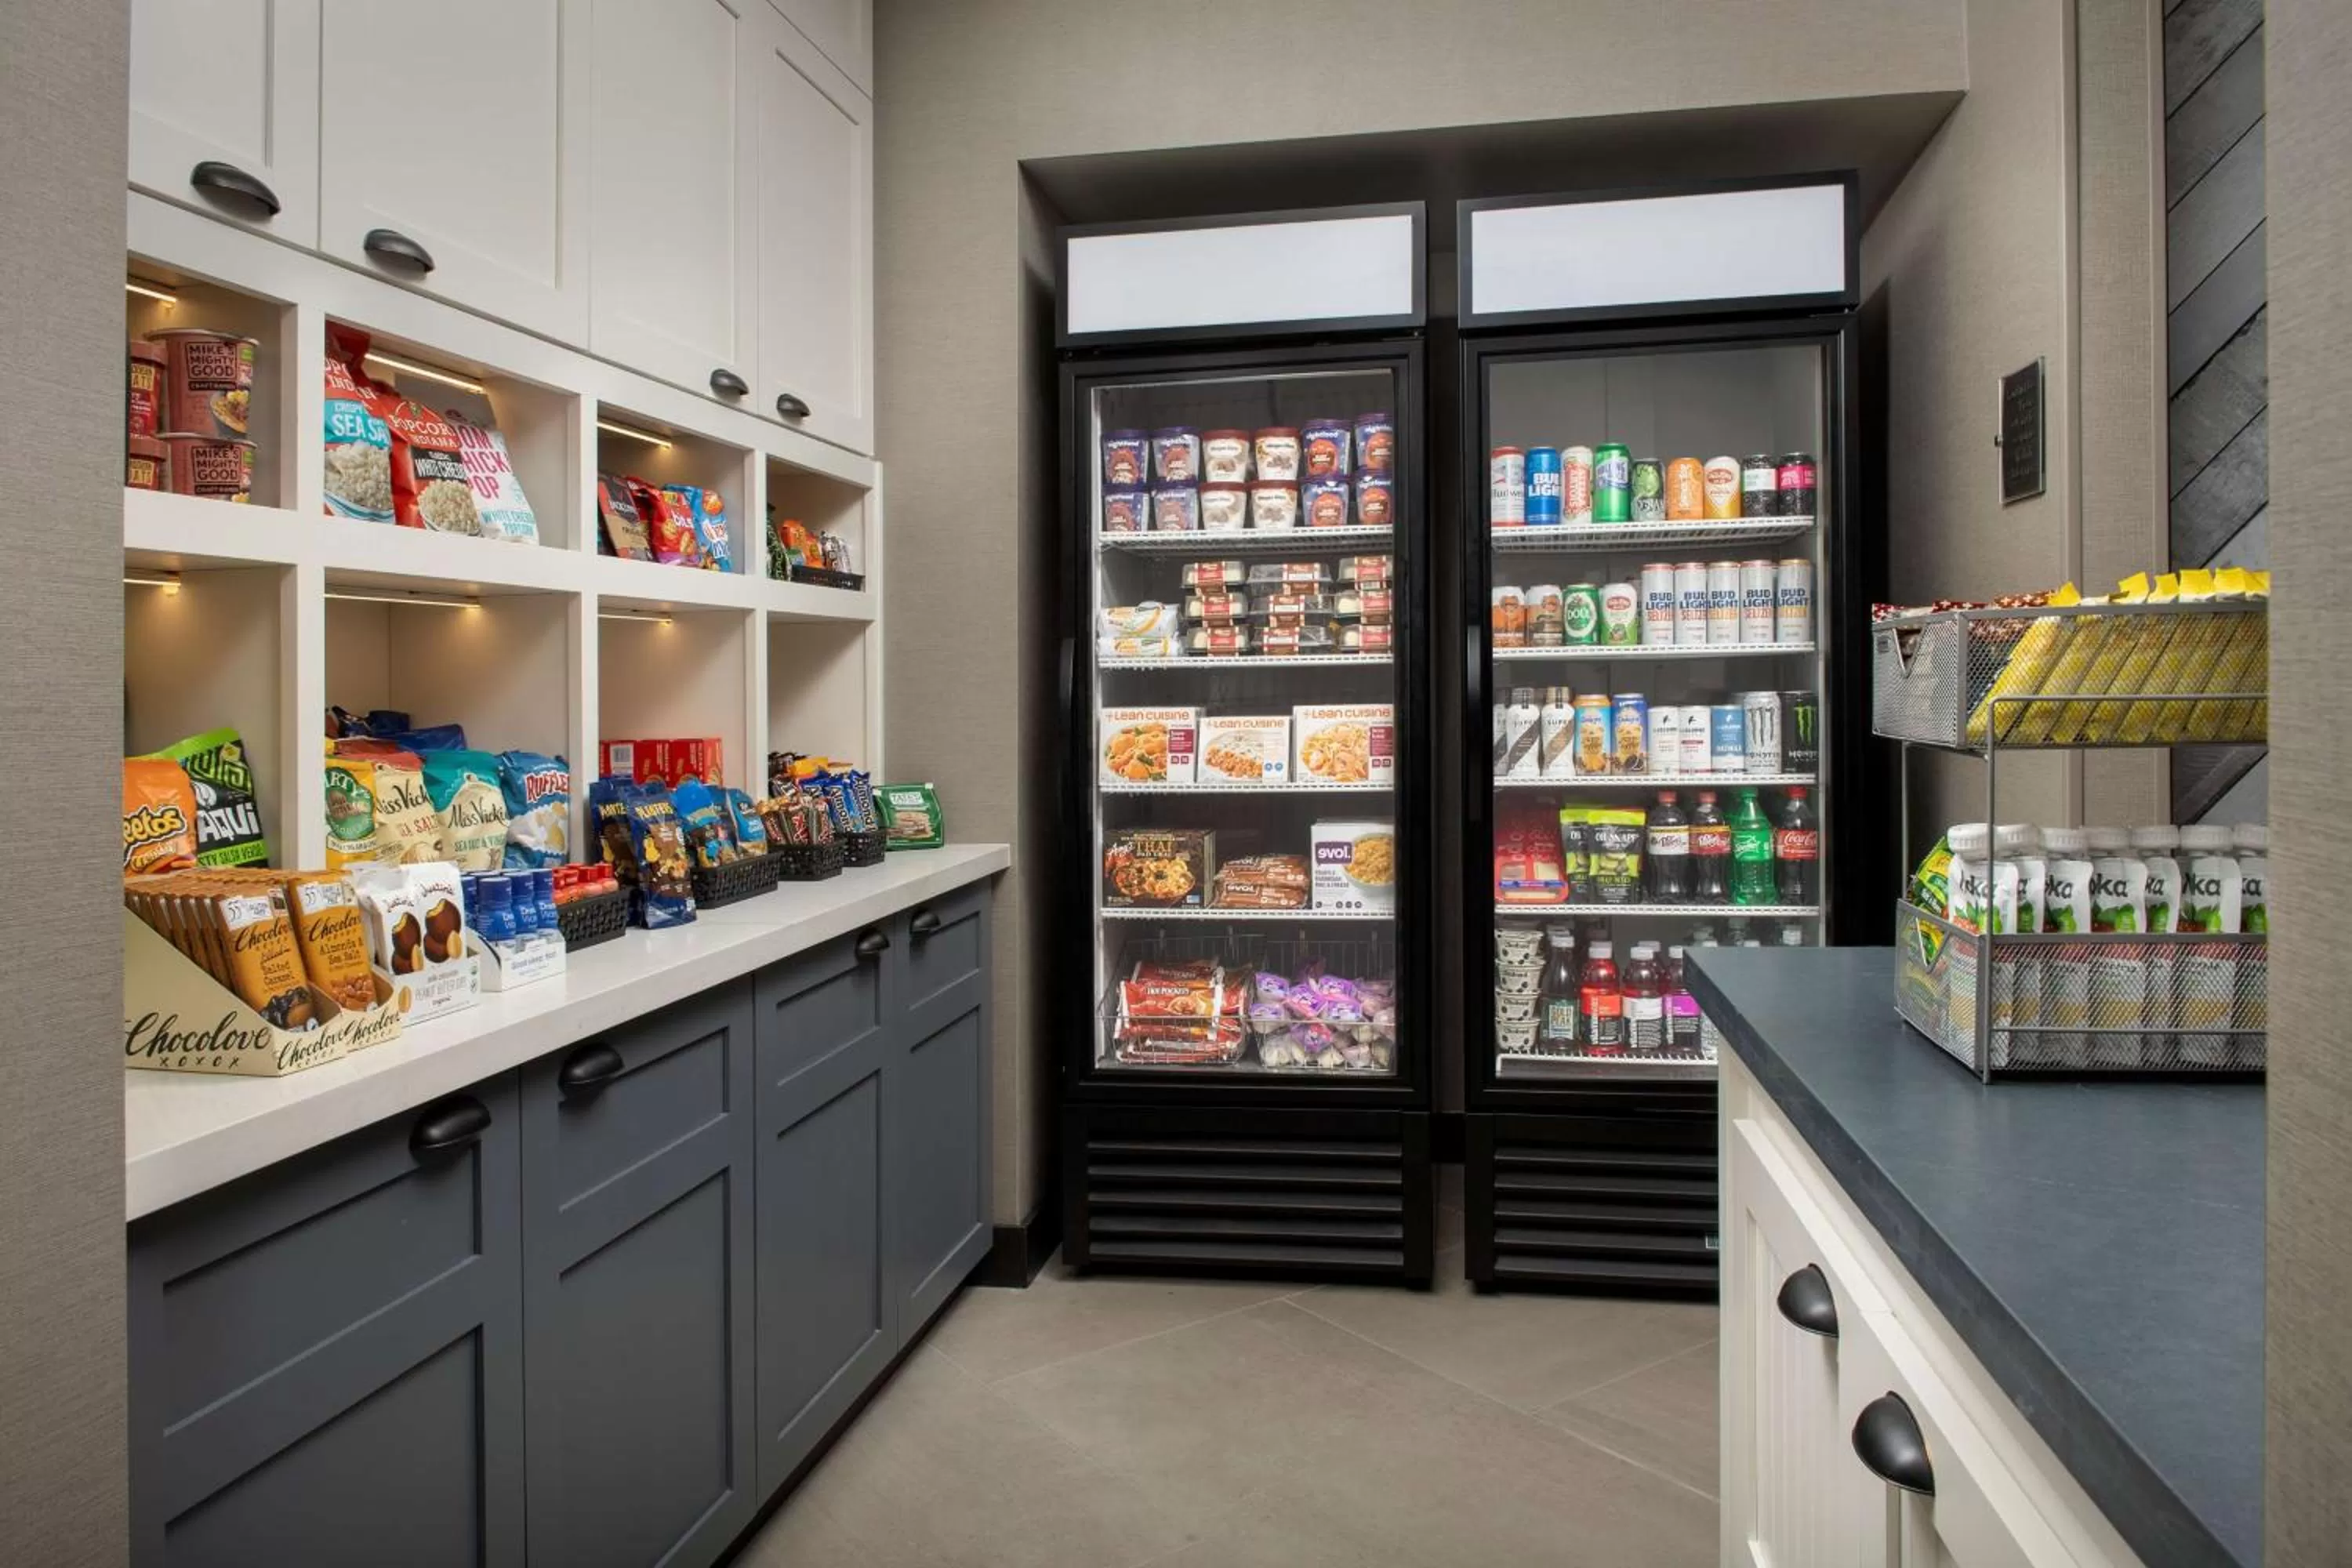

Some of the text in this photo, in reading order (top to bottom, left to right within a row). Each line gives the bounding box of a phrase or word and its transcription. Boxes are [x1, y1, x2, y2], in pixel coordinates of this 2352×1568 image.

[189, 344, 234, 355] MIKE'S
[190, 355, 234, 365] MIGHTY
[191, 365, 234, 377] GOOD
[332, 413, 366, 438] SEA
[196, 448, 239, 459] MIKE'S
[197, 458, 239, 469] MIGHTY
[198, 468, 238, 481] GOOD
[1650, 592, 1673, 601] BUD
[1711, 590, 1736, 600] BUD
[1746, 589, 1772, 598] BUD
[1780, 588, 1806, 597] BUD
[1708, 599, 1739, 609] LIGHT
[1743, 597, 1774, 608] LIGHT
[1777, 597, 1809, 607] LIGHT
[526, 771, 569, 803] RUFFLE
[635, 801, 675, 820] PLANTERS
[124, 808, 181, 843] eetos
[1137, 840, 1173, 853] THAI
[421, 881, 457, 898] Justin's
[125, 1011, 271, 1058] Chocolove
